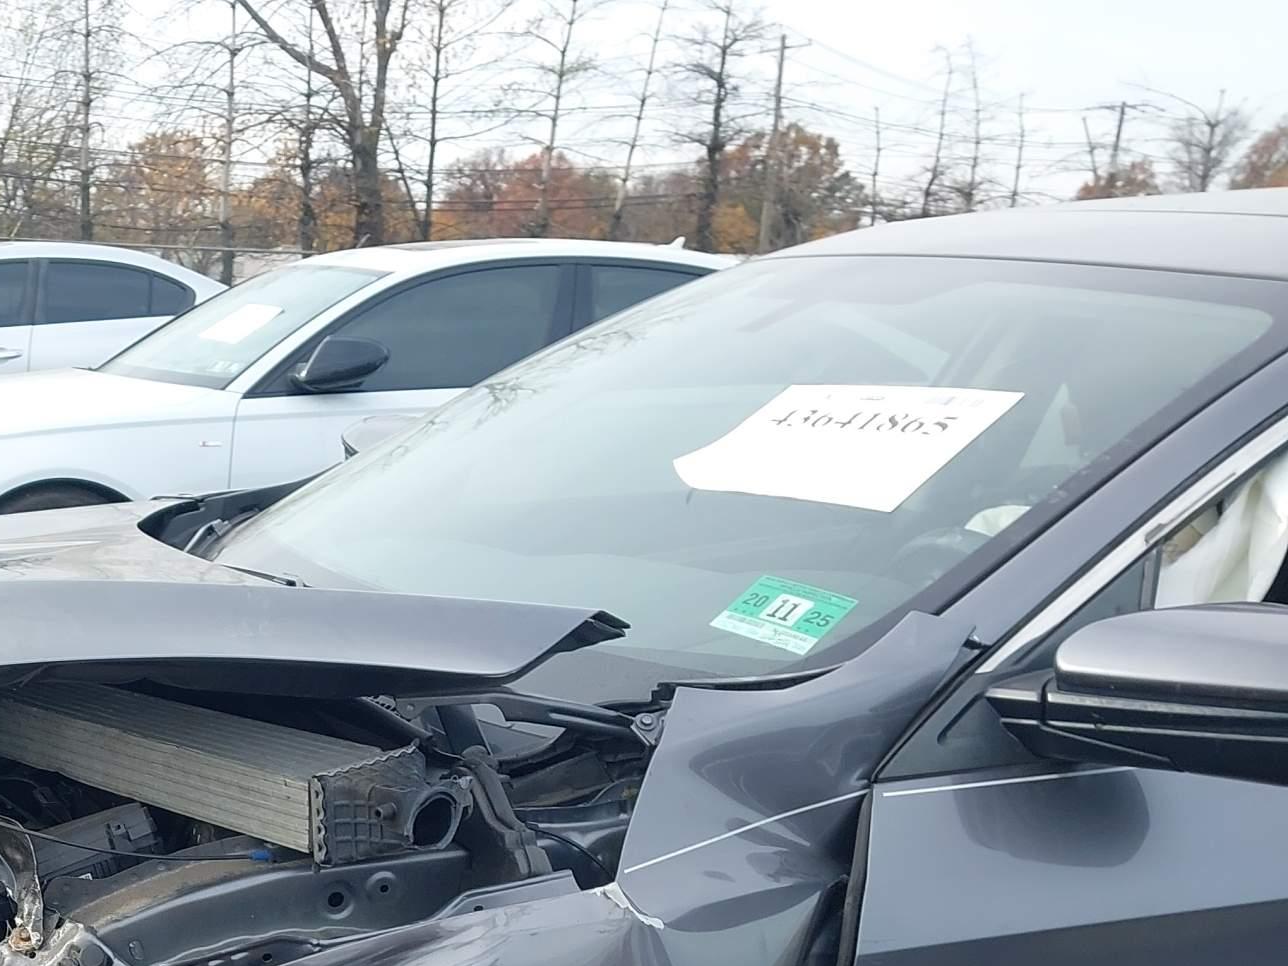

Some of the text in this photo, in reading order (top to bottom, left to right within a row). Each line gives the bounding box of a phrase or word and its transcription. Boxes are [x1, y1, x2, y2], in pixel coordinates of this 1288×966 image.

[771, 408, 959, 436] 43641865
[741, 592, 770, 608] 20
[766, 598, 800, 622] 11
[803, 610, 835, 628] 25
